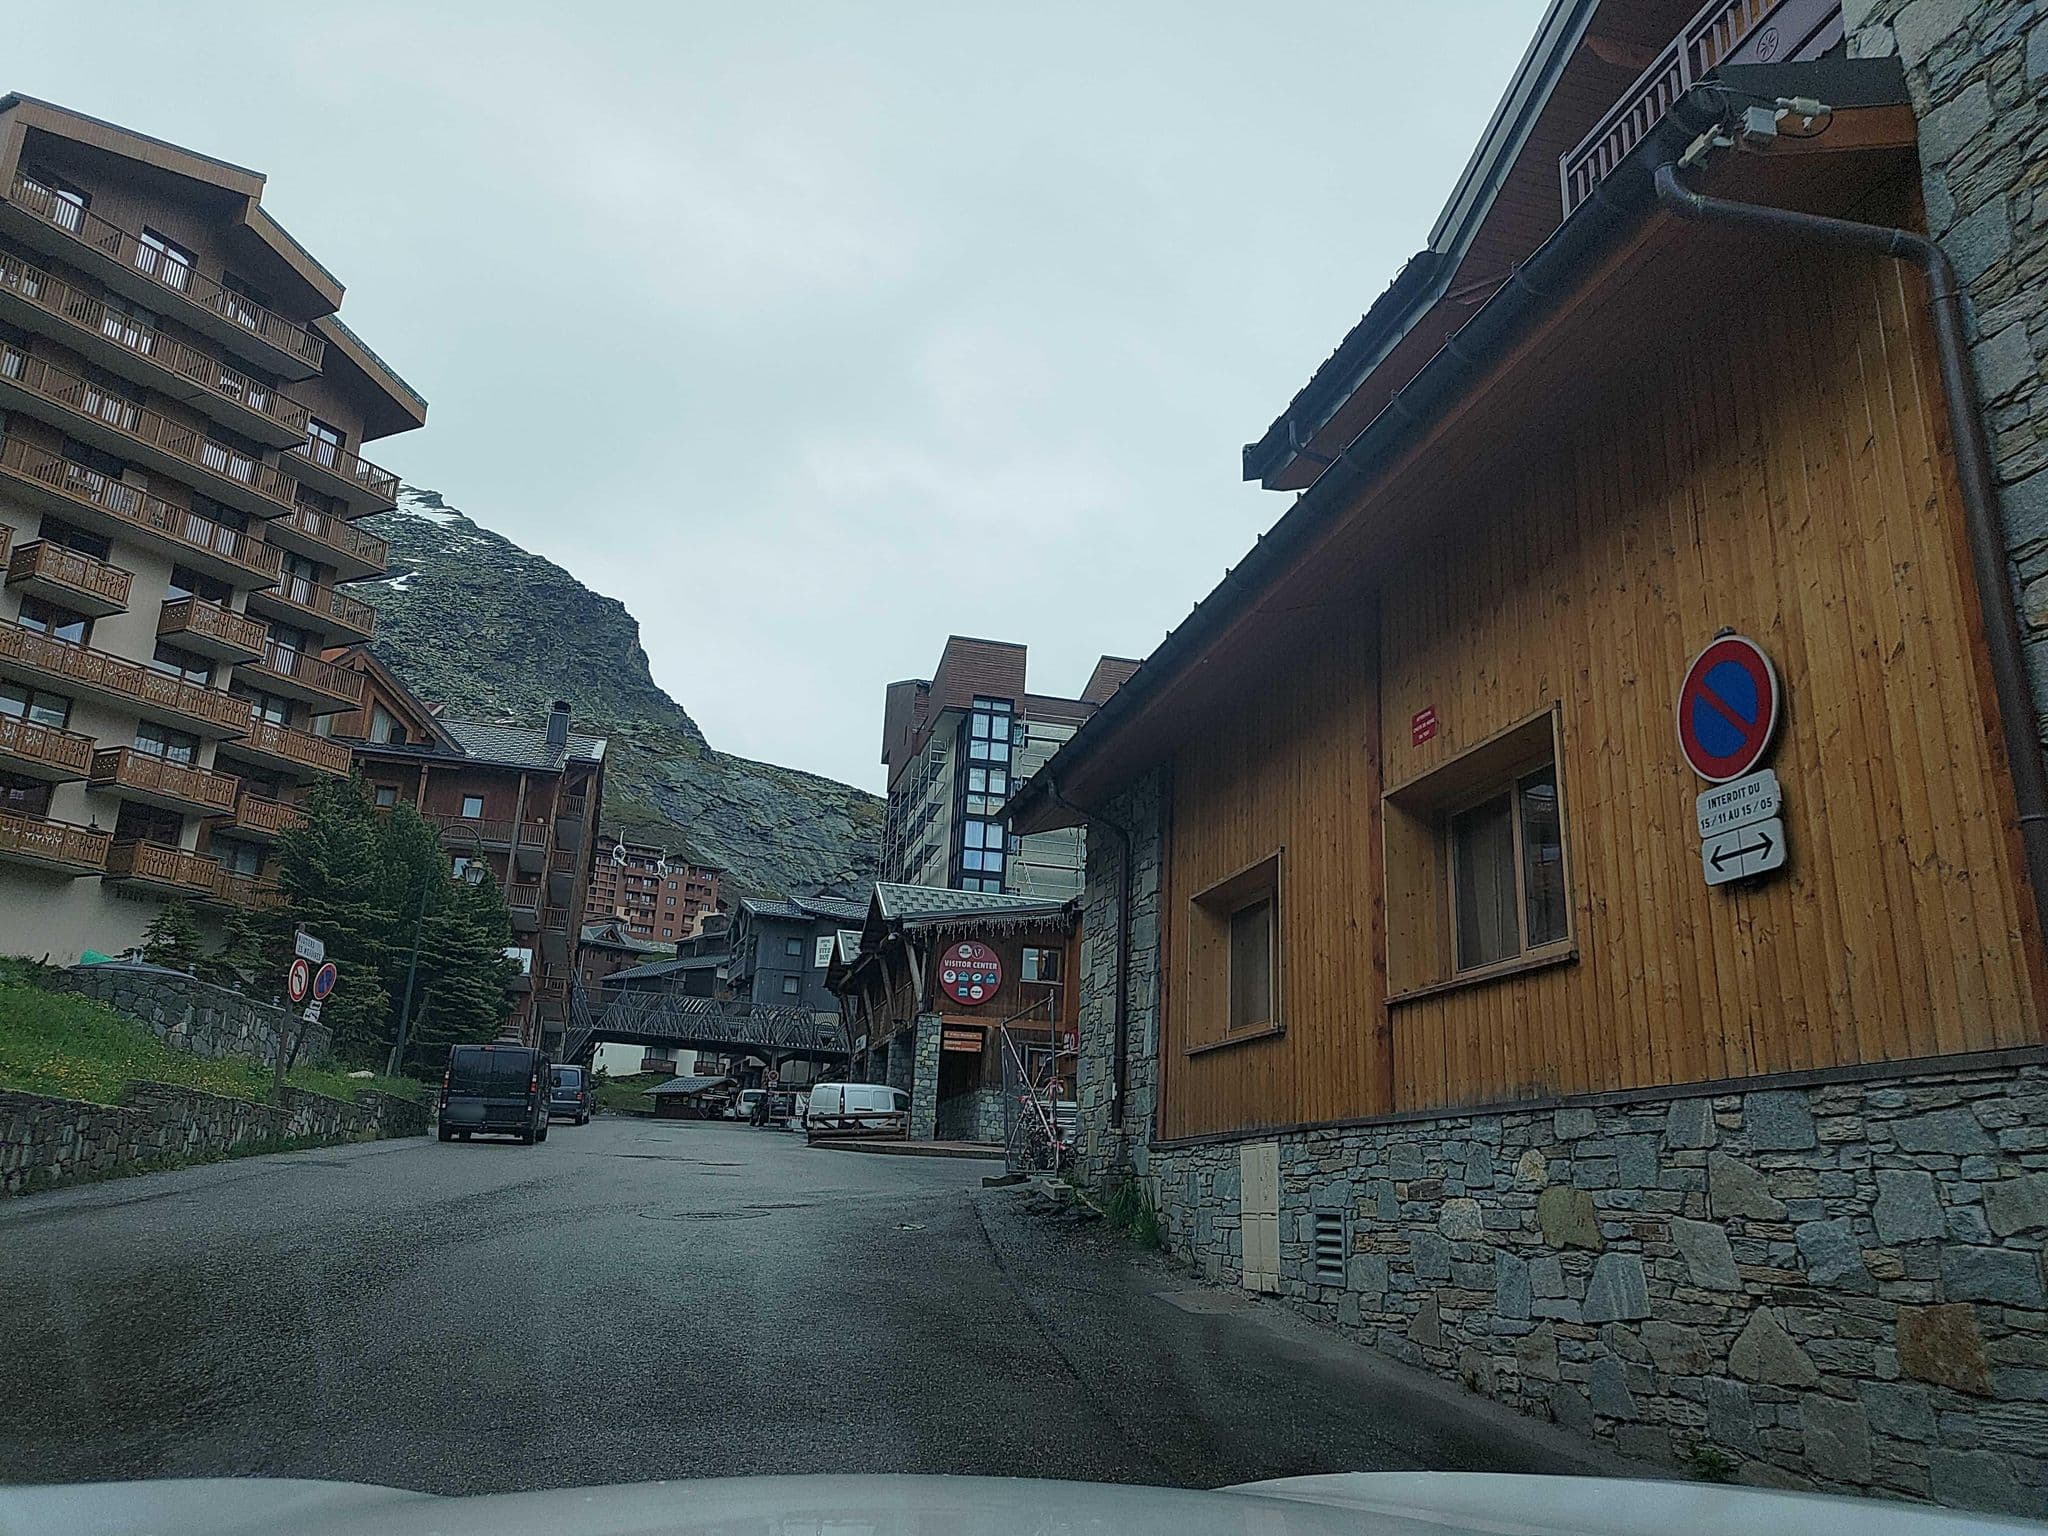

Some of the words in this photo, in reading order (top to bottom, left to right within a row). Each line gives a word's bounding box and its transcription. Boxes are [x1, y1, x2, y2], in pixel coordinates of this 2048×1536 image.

[1707, 786, 1747, 810] INTERDIT
[1748, 781, 1760, 796] DU
[1700, 812, 1727, 830] 15/11
[1728, 807, 1740, 821] AU
[1741, 796, 1773, 816] 15/05
[944, 959, 971, 968] VISITOR
[972, 961, 998, 970] CENTER
